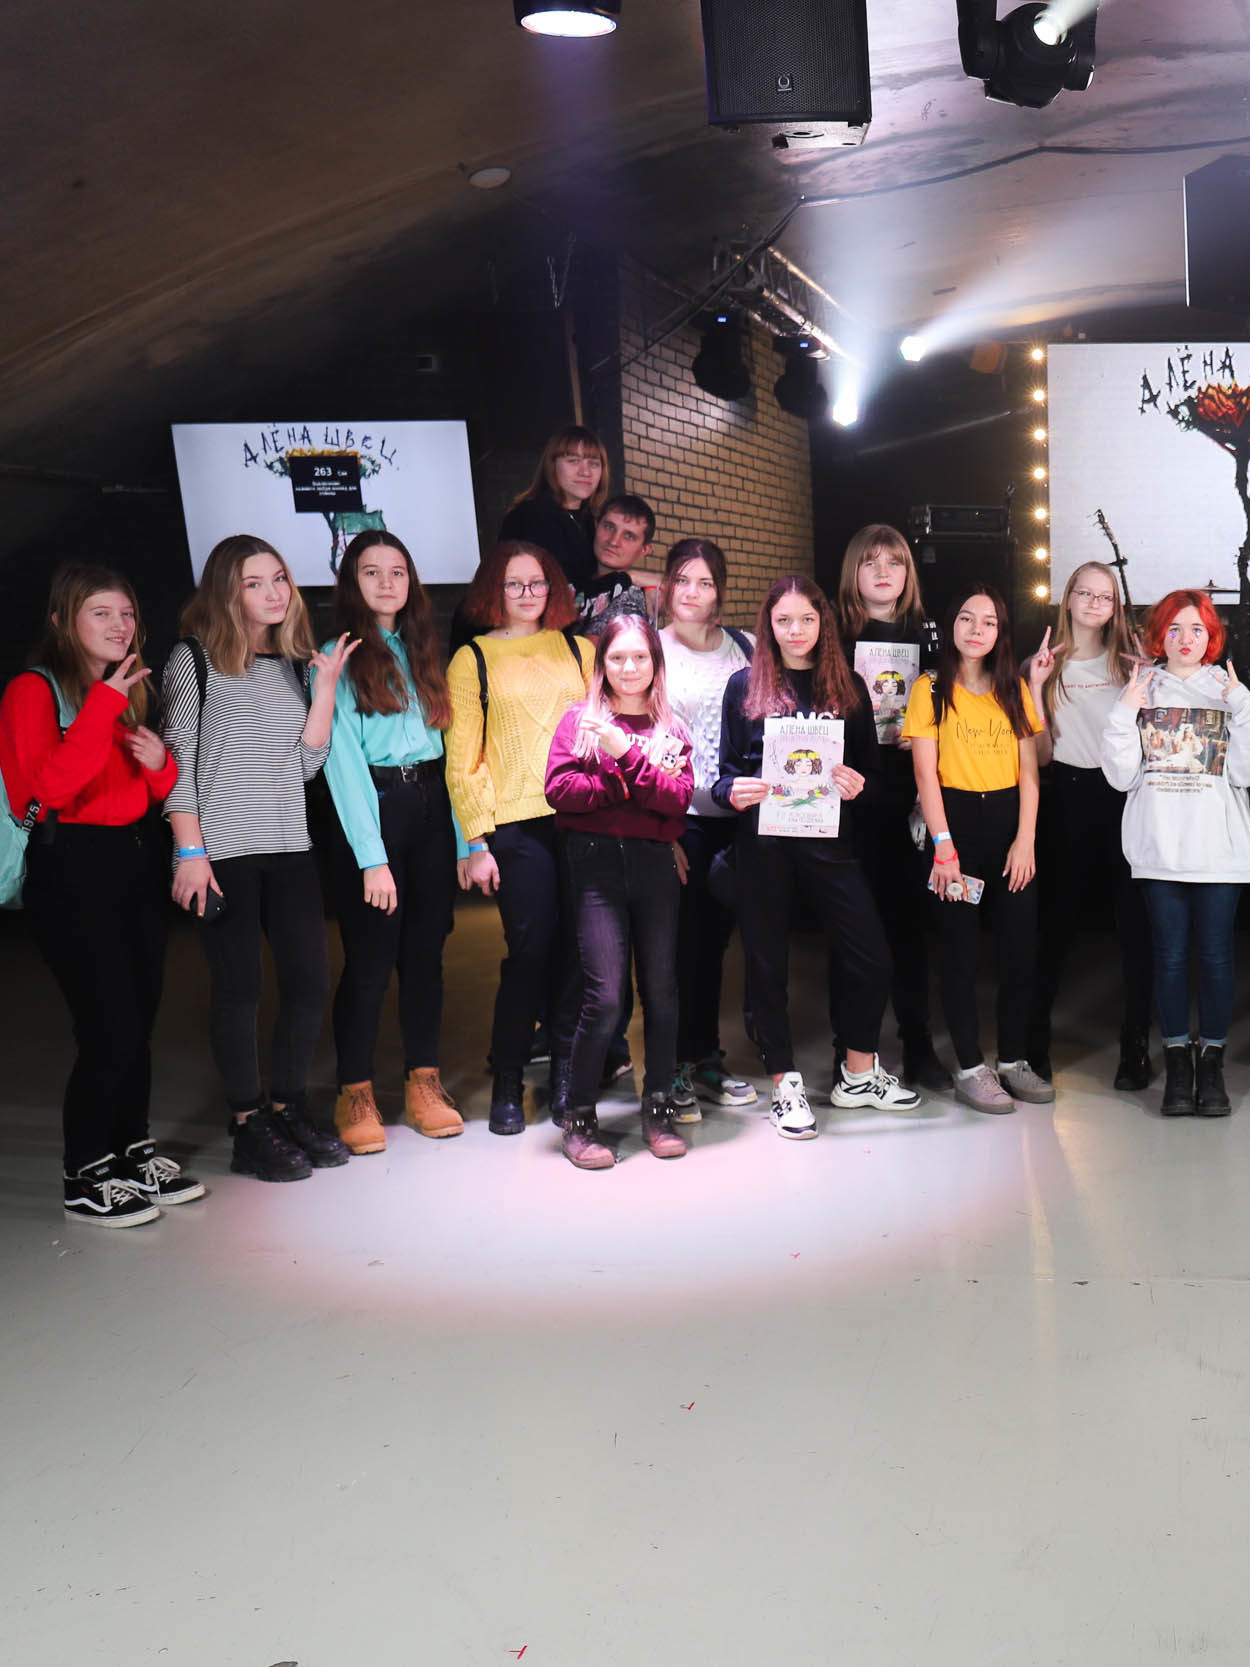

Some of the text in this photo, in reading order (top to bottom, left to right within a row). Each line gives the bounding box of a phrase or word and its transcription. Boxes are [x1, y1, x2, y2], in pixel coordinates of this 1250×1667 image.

[1138, 345, 1235, 415] АЛЁНА
[243, 422, 312, 467] АЛЁНА
[314, 467, 332, 477] 263
